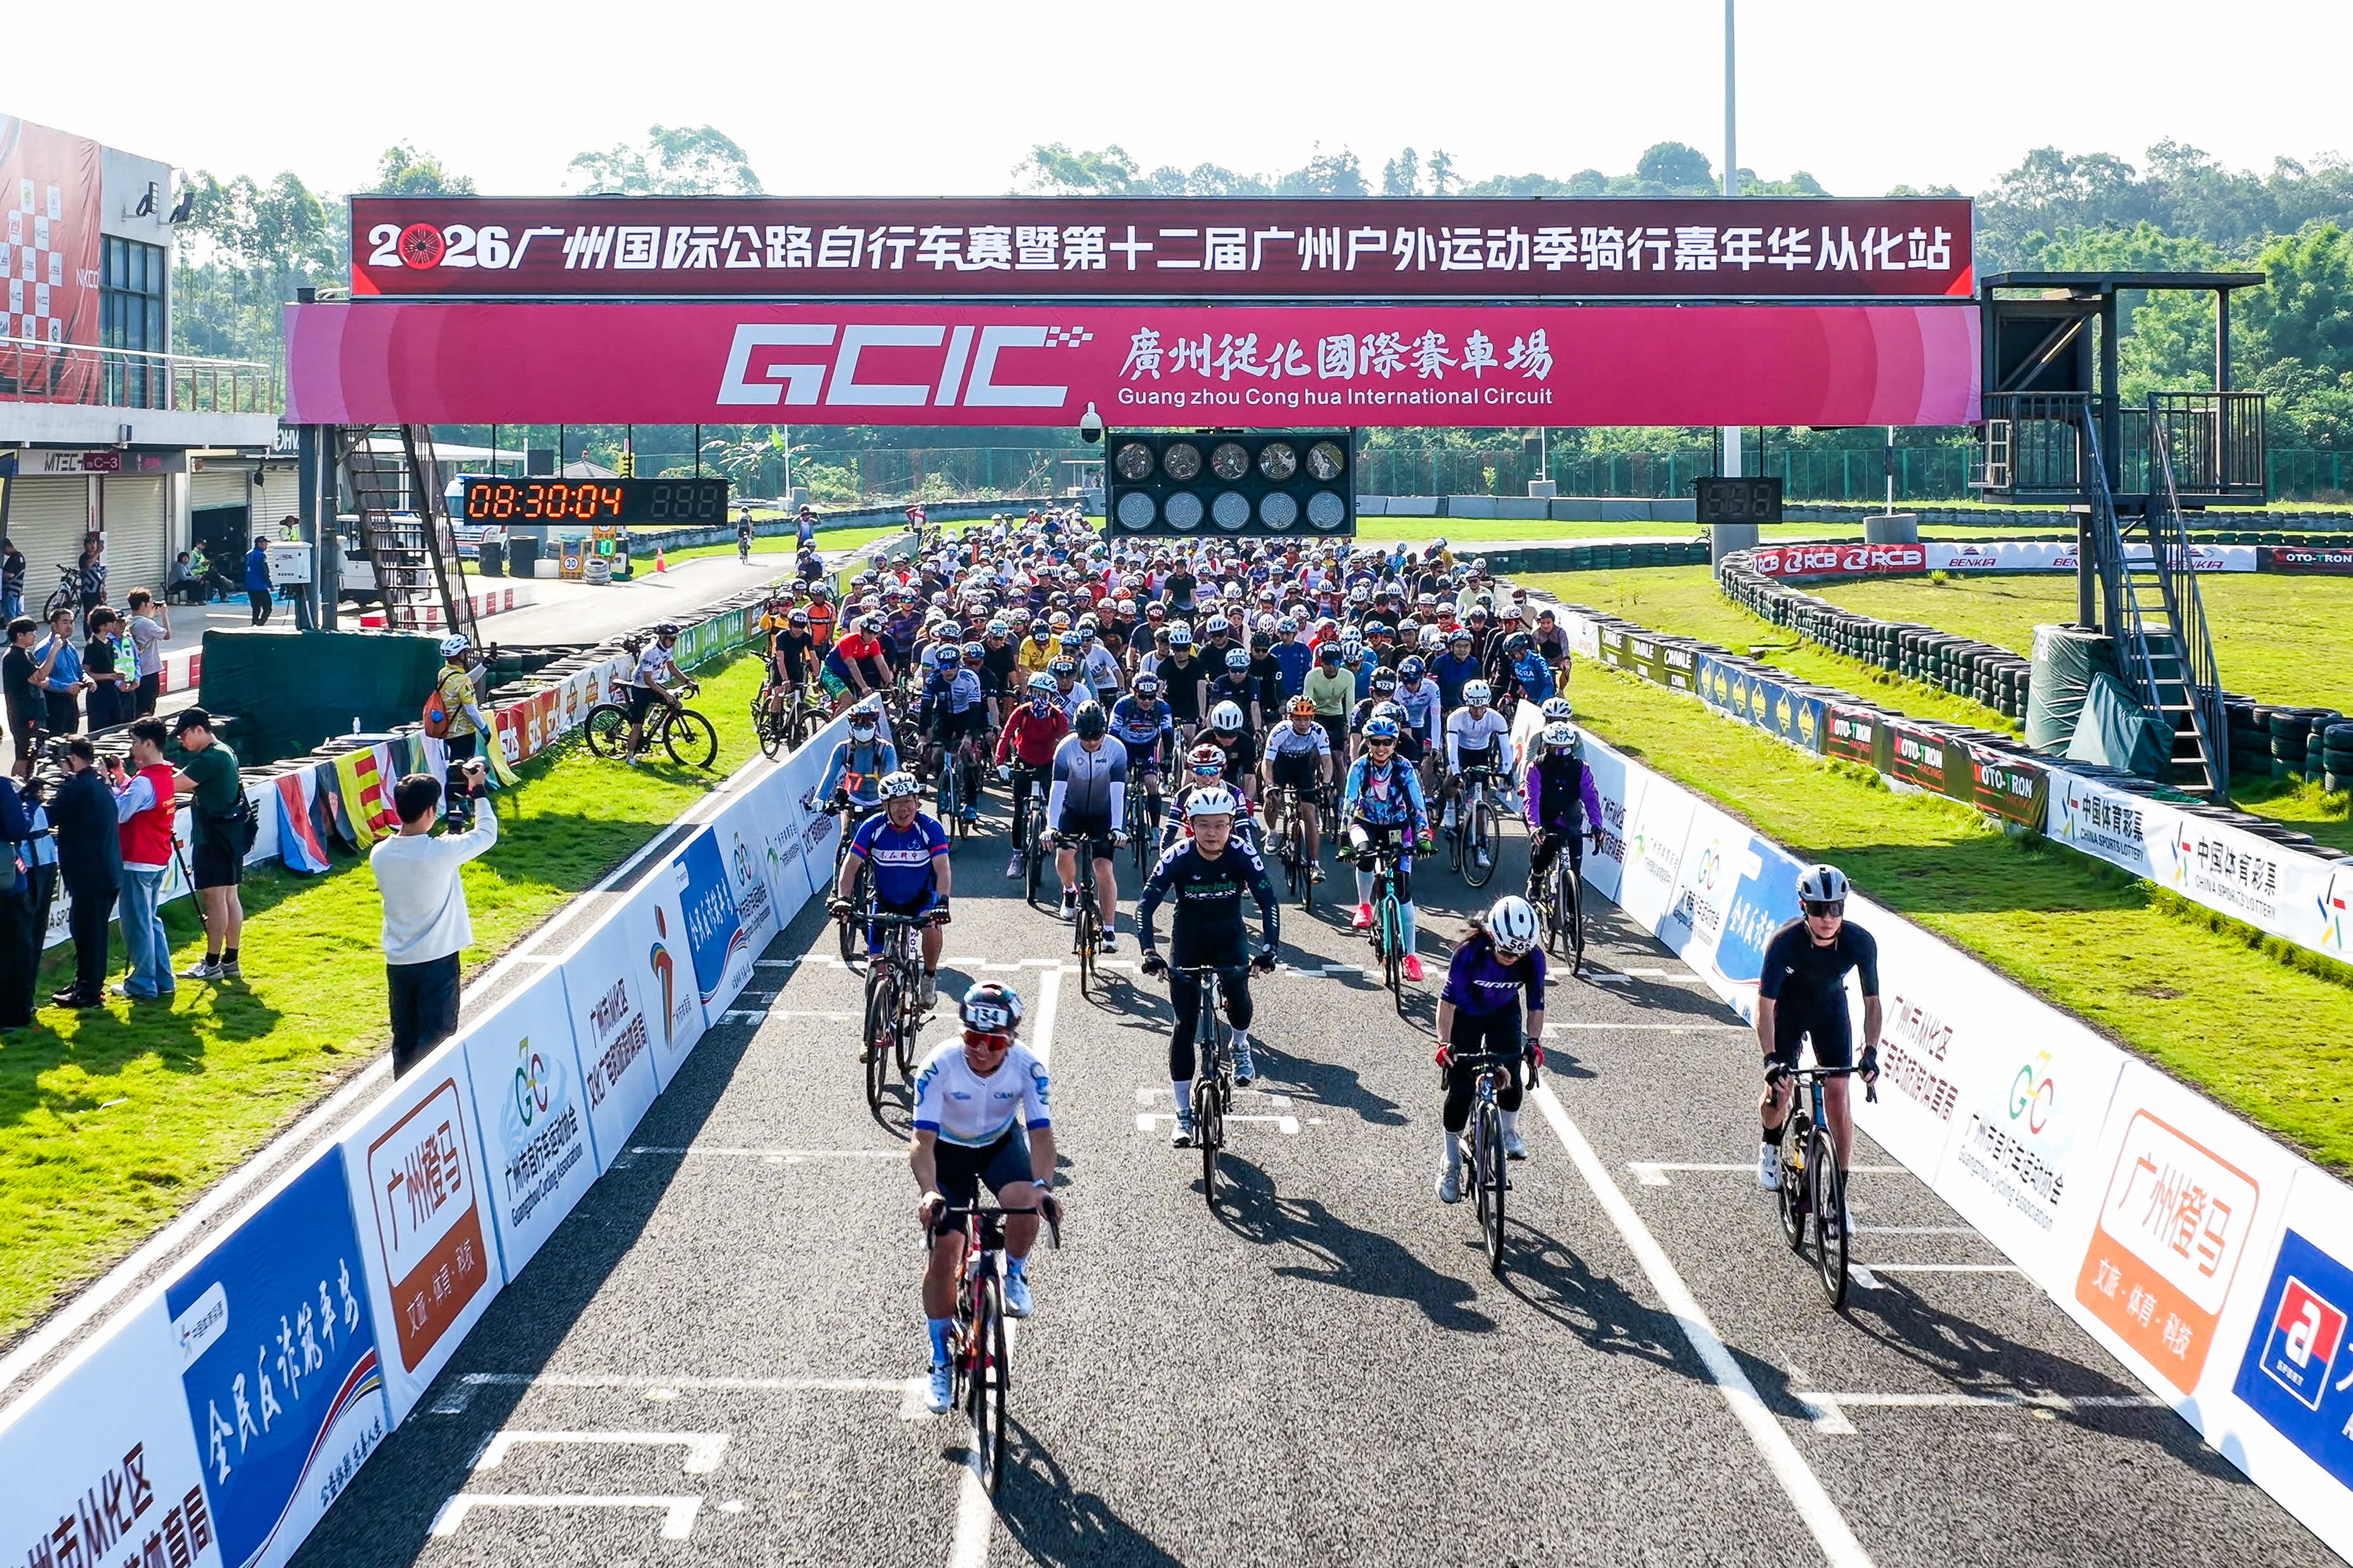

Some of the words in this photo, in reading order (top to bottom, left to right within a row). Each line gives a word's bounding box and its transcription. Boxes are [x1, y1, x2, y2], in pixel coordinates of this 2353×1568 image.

[716, 324, 1069, 407] GCIC
[1118, 327, 1553, 381] 廣州從化國際賽車場
[1118, 388, 1186, 407] Guang
[1191, 388, 1240, 405] zhou
[1245, 388, 1299, 407] Cong
[1305, 388, 1343, 405] hua
[1348, 388, 1479, 405] International
[1484, 388, 1553, 405] Circuit
[94, 458, 118, 468] C-3
[469, 484, 622, 519] 08:30:04
[566, 559, 577, 568] 30
[1758, 555, 1780, 573] RCB
[1804, 552, 1837, 568] RCB
[1871, 550, 1922, 566] RCB
[1949, 558, 1996, 566] BENKIA
[1894, 737, 1943, 769] MOTO-TRON
[892, 783, 909, 793] 503
[1974, 763, 2033, 799] MOTO-TRON
[2081, 793, 2144, 843] 中国体育彩票
[2080, 826, 2098, 845] CHINA
[2098, 835, 2123, 856] SPORTS
[2121, 843, 2144, 864] LOTTERY
[2197, 835, 2279, 897] 中国体育彩票
[2195, 873, 2217, 895] CHINA
[2216, 882, 2247, 911] SPORTS
[2245, 894, 2277, 922] LOTTERY
[388, 1119, 462, 1252] 广州橙马
[2118, 1152, 2232, 1279] 广州橙马
